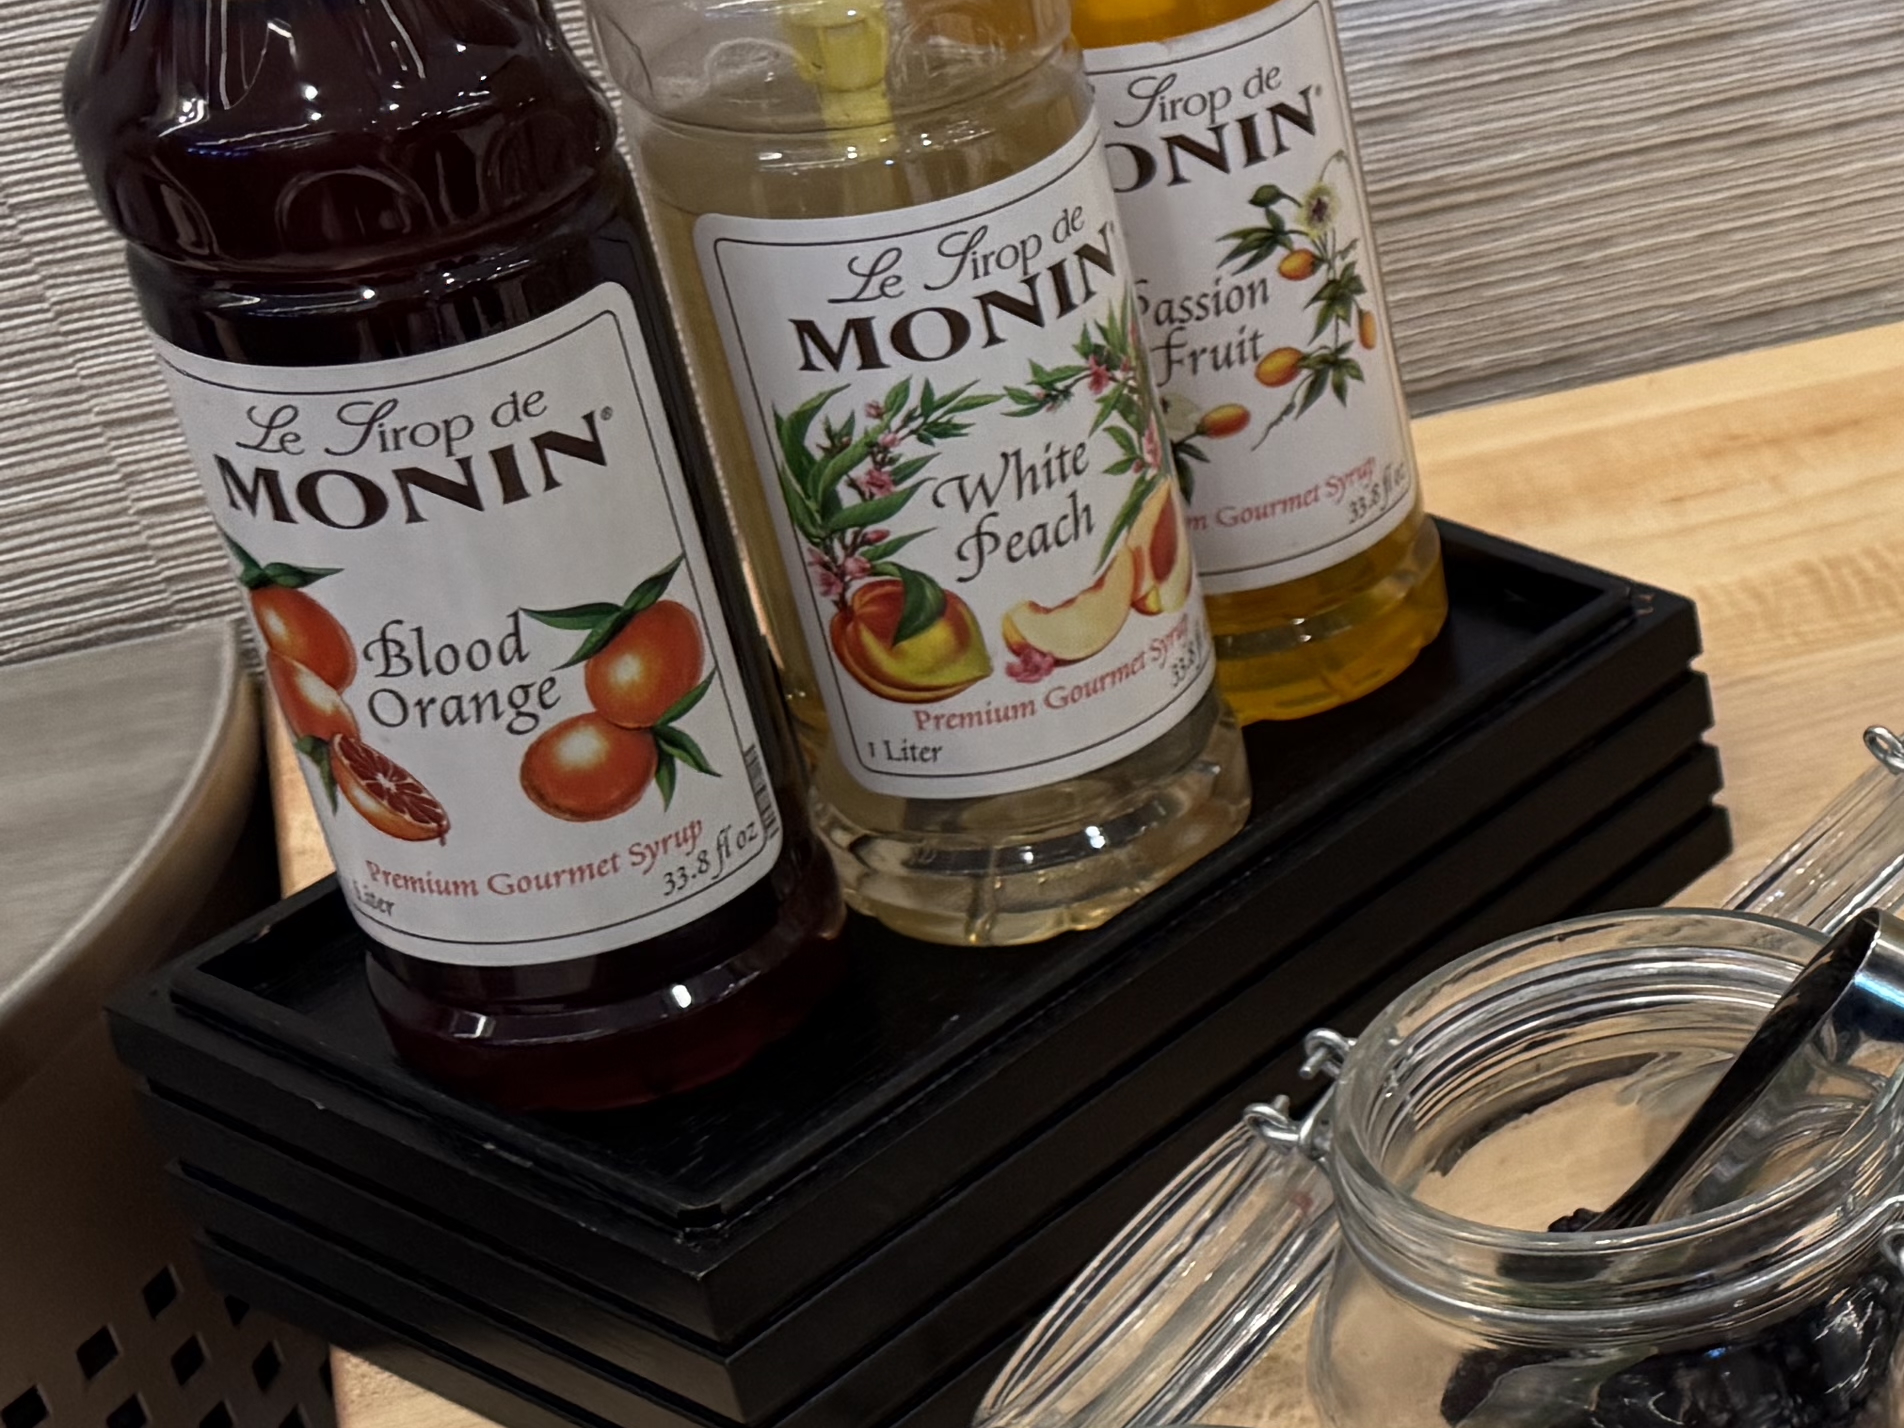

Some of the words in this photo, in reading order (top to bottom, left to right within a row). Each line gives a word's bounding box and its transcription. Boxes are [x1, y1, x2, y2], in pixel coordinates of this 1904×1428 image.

[1113, 72, 1232, 129] Sirop
[1243, 66, 1282, 99] de
[1104, 84, 1316, 194] ONIN
[827, 246, 906, 304] Le
[923, 224, 1043, 292] Sirop
[1052, 204, 1086, 244] de
[1151, 323, 1265, 388] Fruit
[236, 402, 305, 457] Le
[325, 397, 475, 458] Sirop
[492, 384, 548, 427] de
[931, 437, 1091, 518] White
[1215, 483, 1320, 529] Gourmet
[954, 489, 1096, 583] Peach
[362, 607, 531, 679] Blood
[367, 672, 564, 736] Orange
[912, 698, 1037, 732] Premium
[1044, 651, 1147, 711] Gourmet
[883, 737, 944, 764] Liter
[365, 859, 480, 897] Premium
[487, 852, 621, 897] Gourmet
[629, 819, 703, 876] Syrup
[663, 849, 711, 896] 33.8
[711, 823, 732, 880] fl
[736, 820, 758, 850] oz
